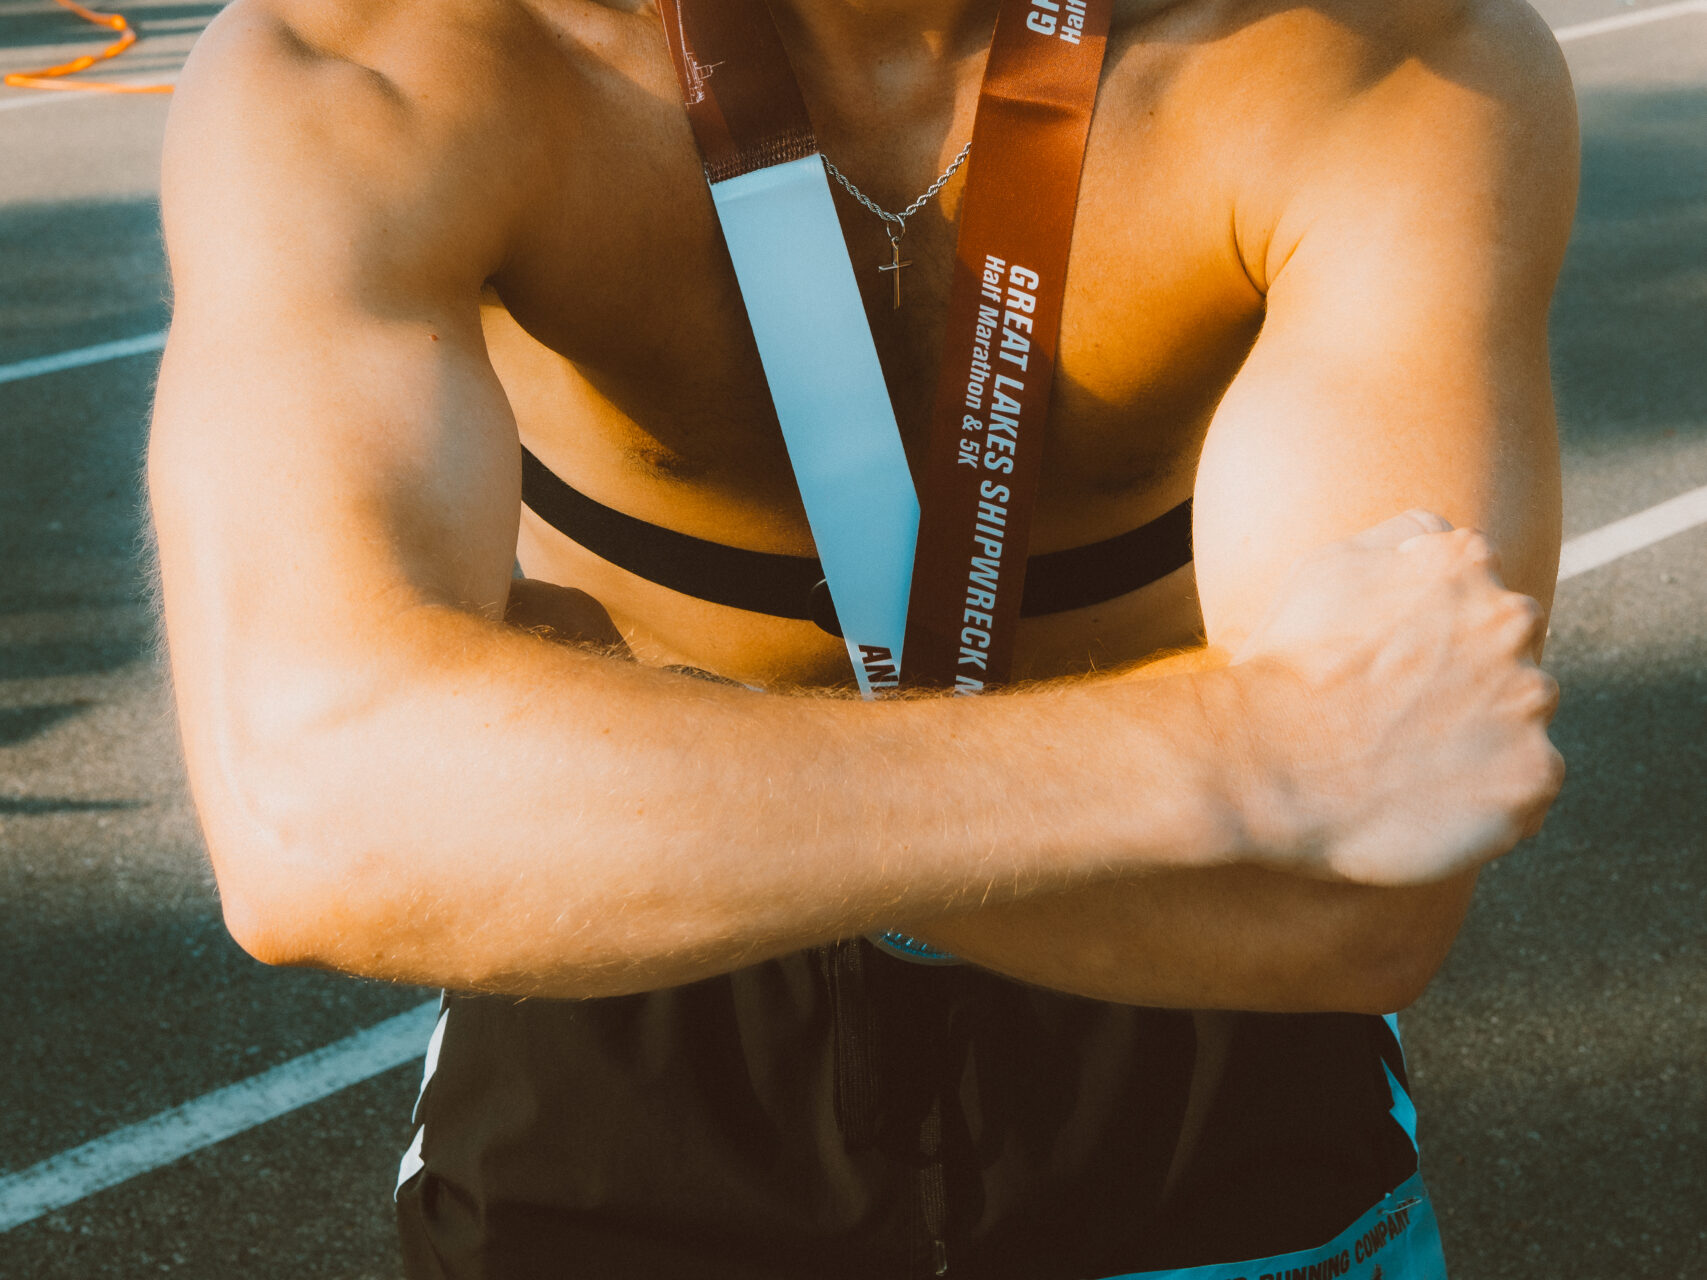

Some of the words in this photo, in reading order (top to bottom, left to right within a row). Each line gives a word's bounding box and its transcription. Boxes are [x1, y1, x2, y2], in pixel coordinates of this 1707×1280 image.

[981, 254, 1006, 303] Half
[999, 264, 1040, 373] GREAT
[965, 303, 999, 410] Marathon
[957, 438, 980, 469] 5K
[961, 414, 983, 432] &
[983, 373, 1025, 475] LAKES
[957, 479, 1011, 671] SHIPWRECK
[858, 644, 900, 693] AN
